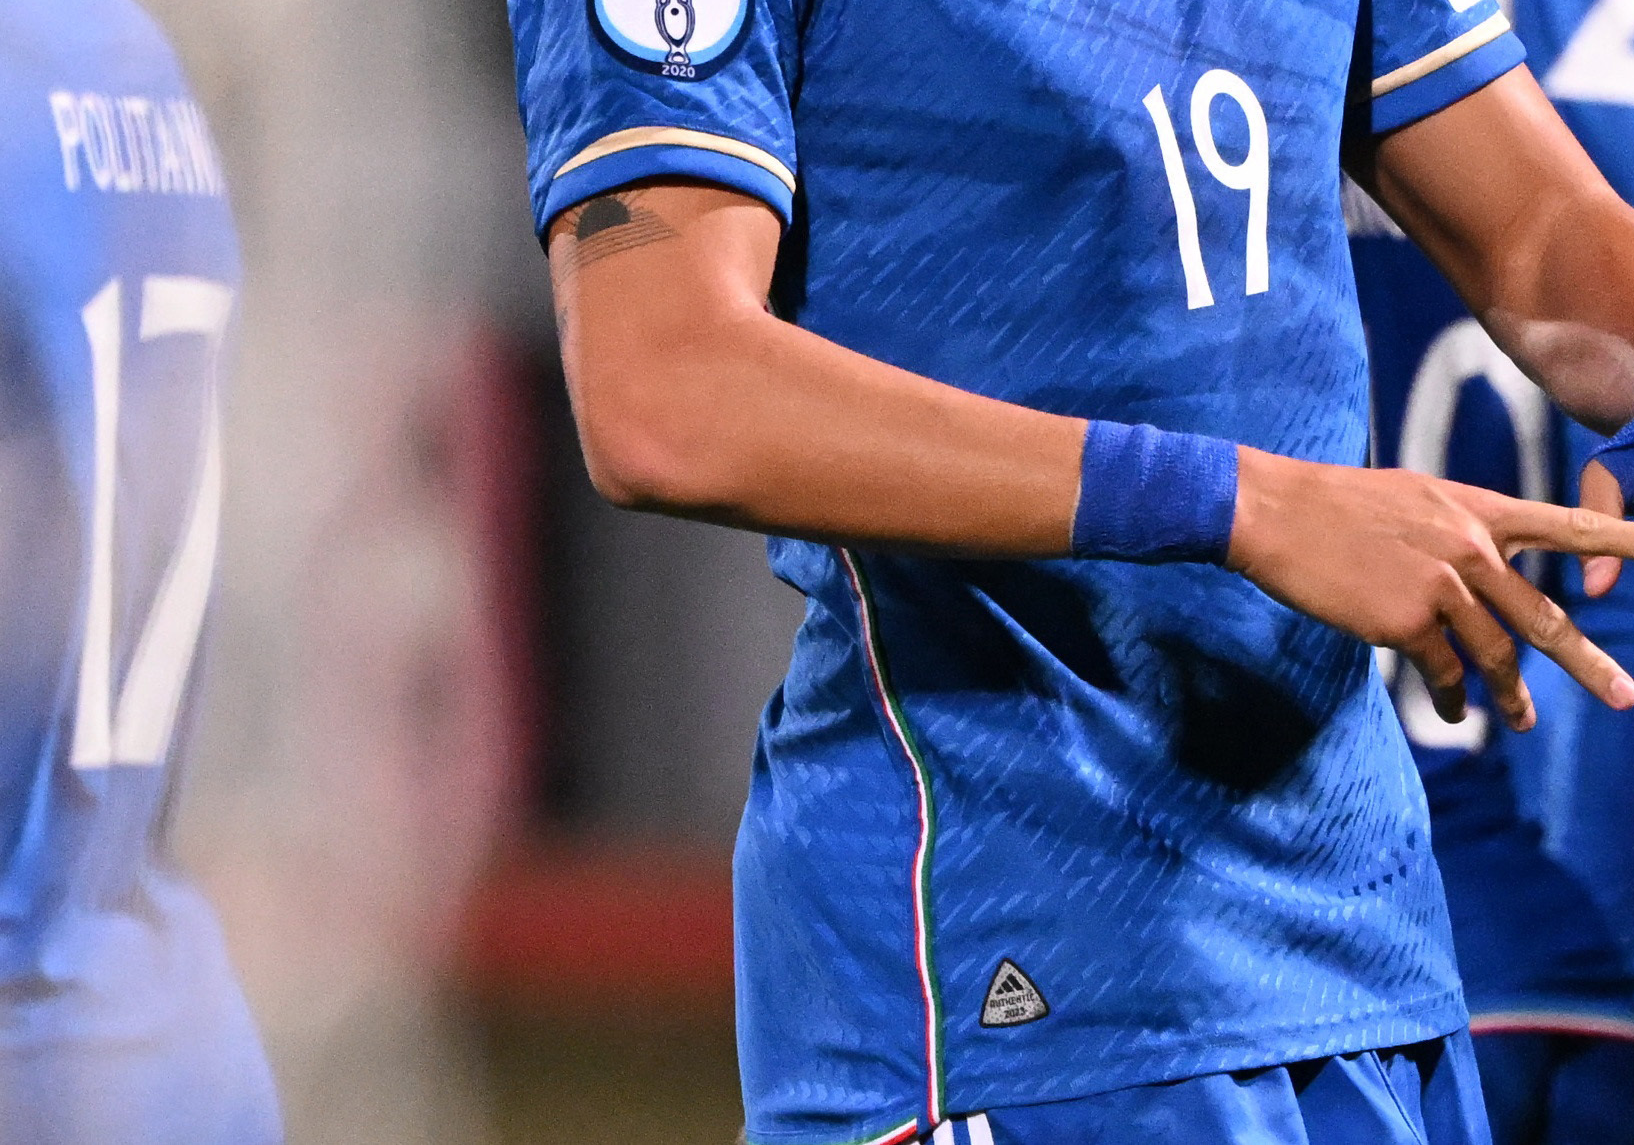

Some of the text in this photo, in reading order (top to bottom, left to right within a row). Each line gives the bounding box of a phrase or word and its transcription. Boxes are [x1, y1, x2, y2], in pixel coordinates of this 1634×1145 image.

[661, 64, 696, 78] 2020
[49, 89, 222, 197] POLITAN
[1142, 68, 1270, 311] 19
[70, 274, 234, 768] 17
[989, 993, 1035, 1008] AUTHENTIC
